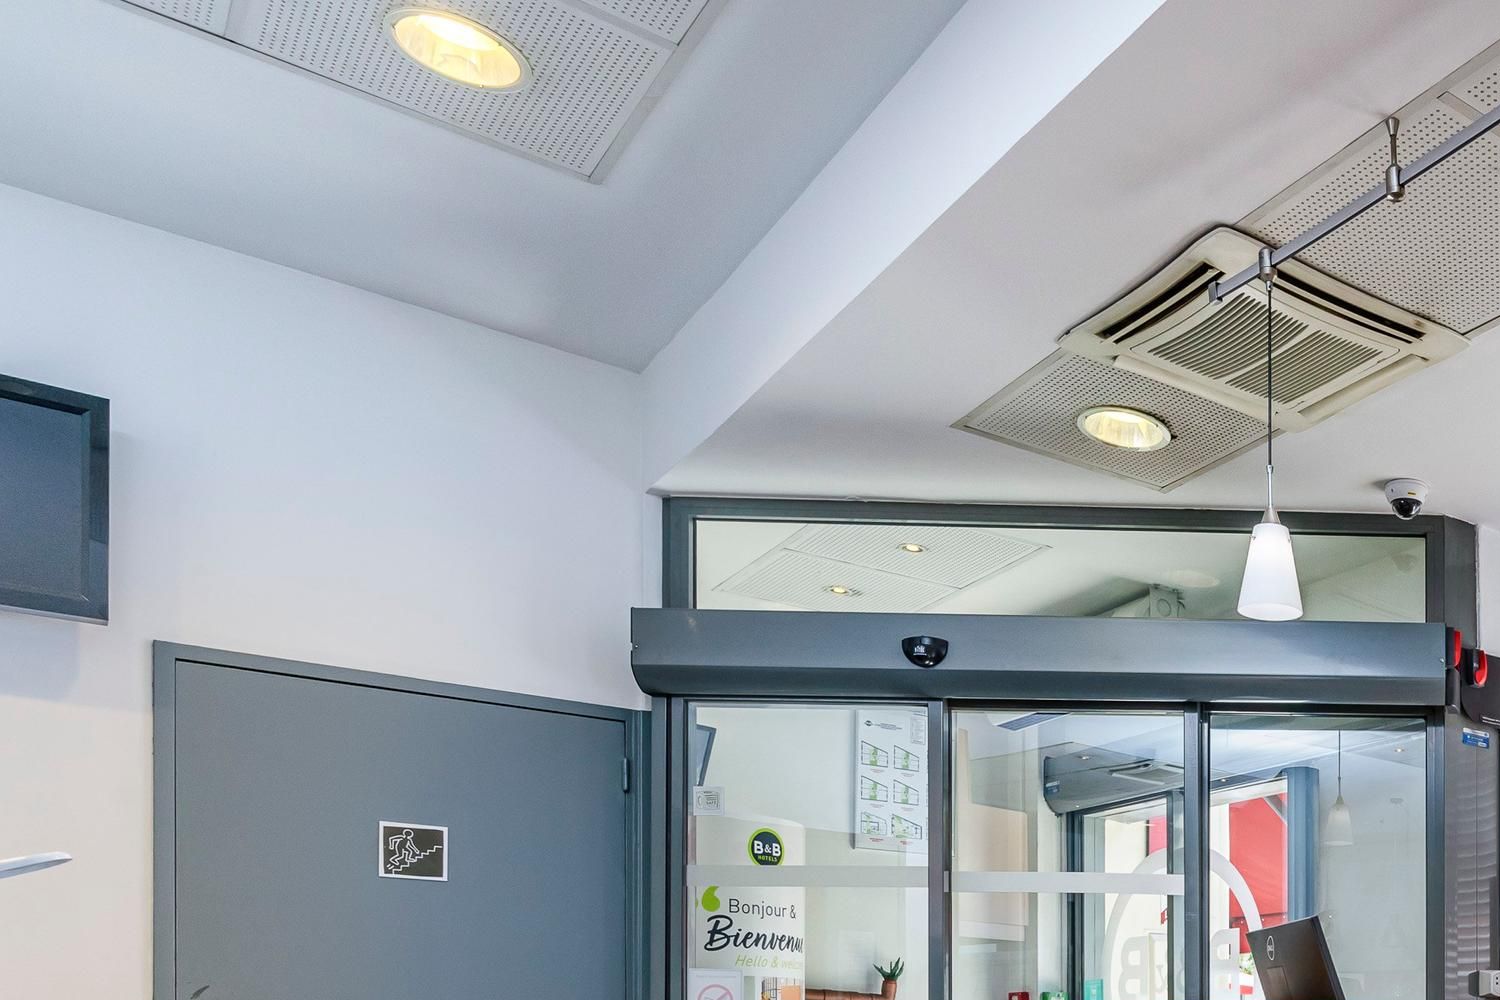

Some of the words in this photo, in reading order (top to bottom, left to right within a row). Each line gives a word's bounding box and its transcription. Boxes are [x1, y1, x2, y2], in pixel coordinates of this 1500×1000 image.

[753, 839, 782, 856] B&B
[757, 854, 778, 863] HOTELS
[728, 898, 788, 920] Bonjour
[790, 904, 796, 919] &
[735, 954, 769, 968] Hello
